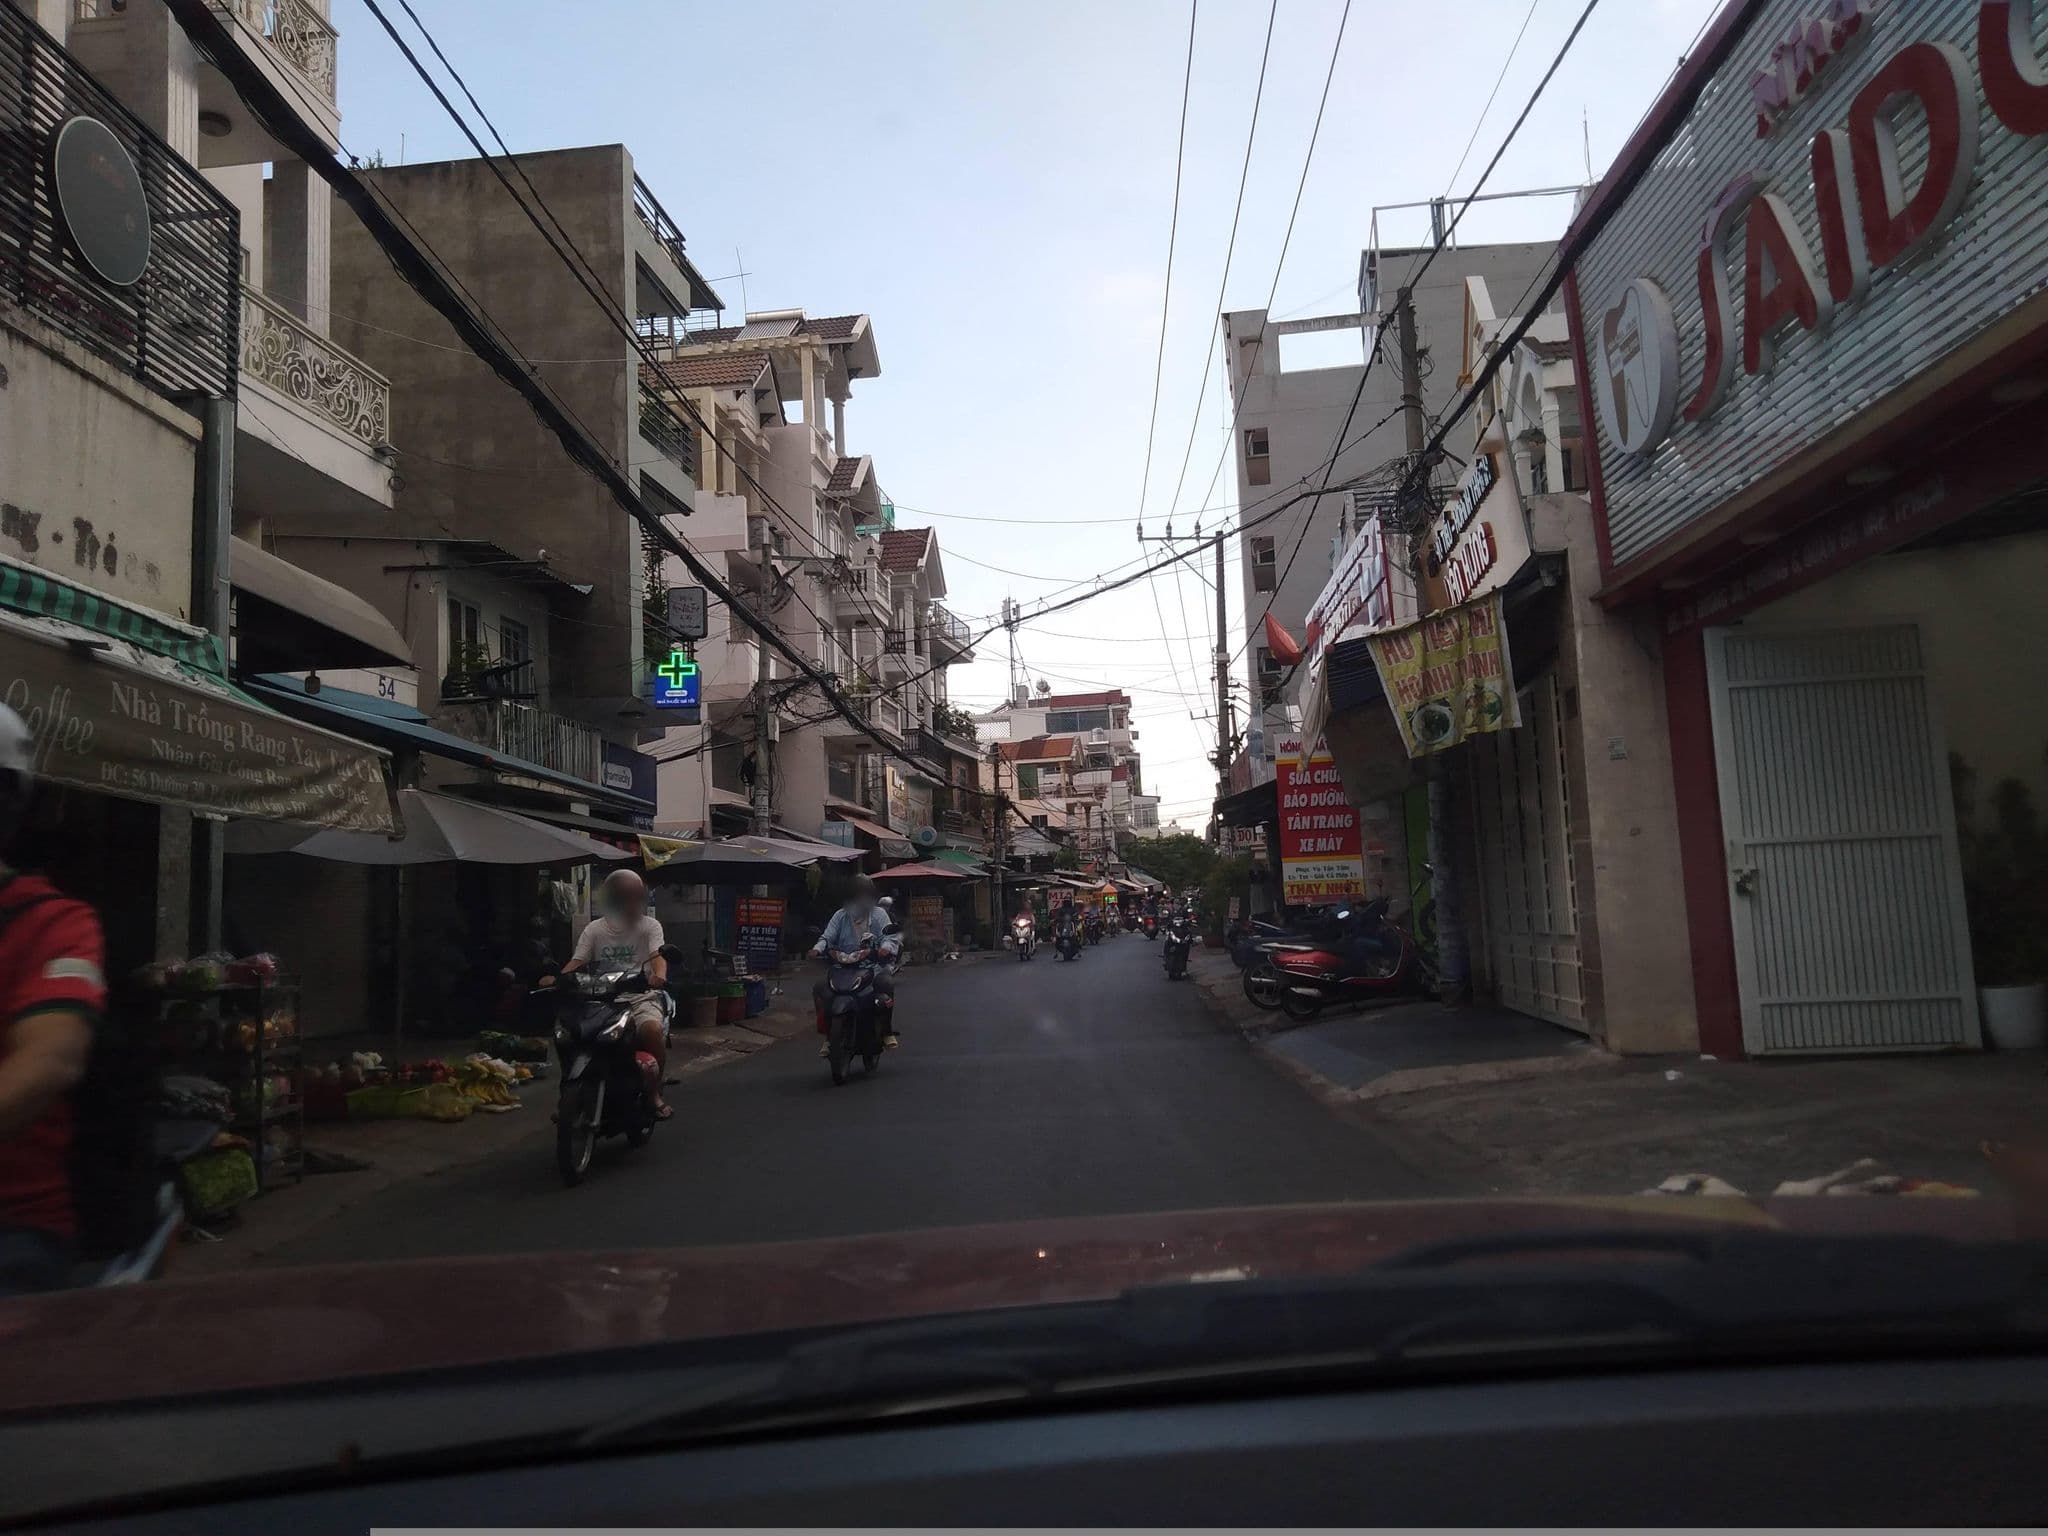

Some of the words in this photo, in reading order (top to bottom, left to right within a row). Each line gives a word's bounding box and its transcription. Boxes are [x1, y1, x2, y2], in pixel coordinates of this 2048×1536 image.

[378, 674, 395, 700] 54
[110, 681, 162, 726] Nhà
[239, 719, 288, 768] Rang
[291, 736, 321, 775] Xay
[354, 758, 386, 784] Ch
[1284, 789, 1309, 809] BẢO
[1287, 813, 1312, 831] TÂN
[1313, 815, 1353, 830] TRANG
[1299, 838, 1315, 853] XE
[1316, 833, 1343, 852] MÁY
[1287, 883, 1322, 896] THAY
